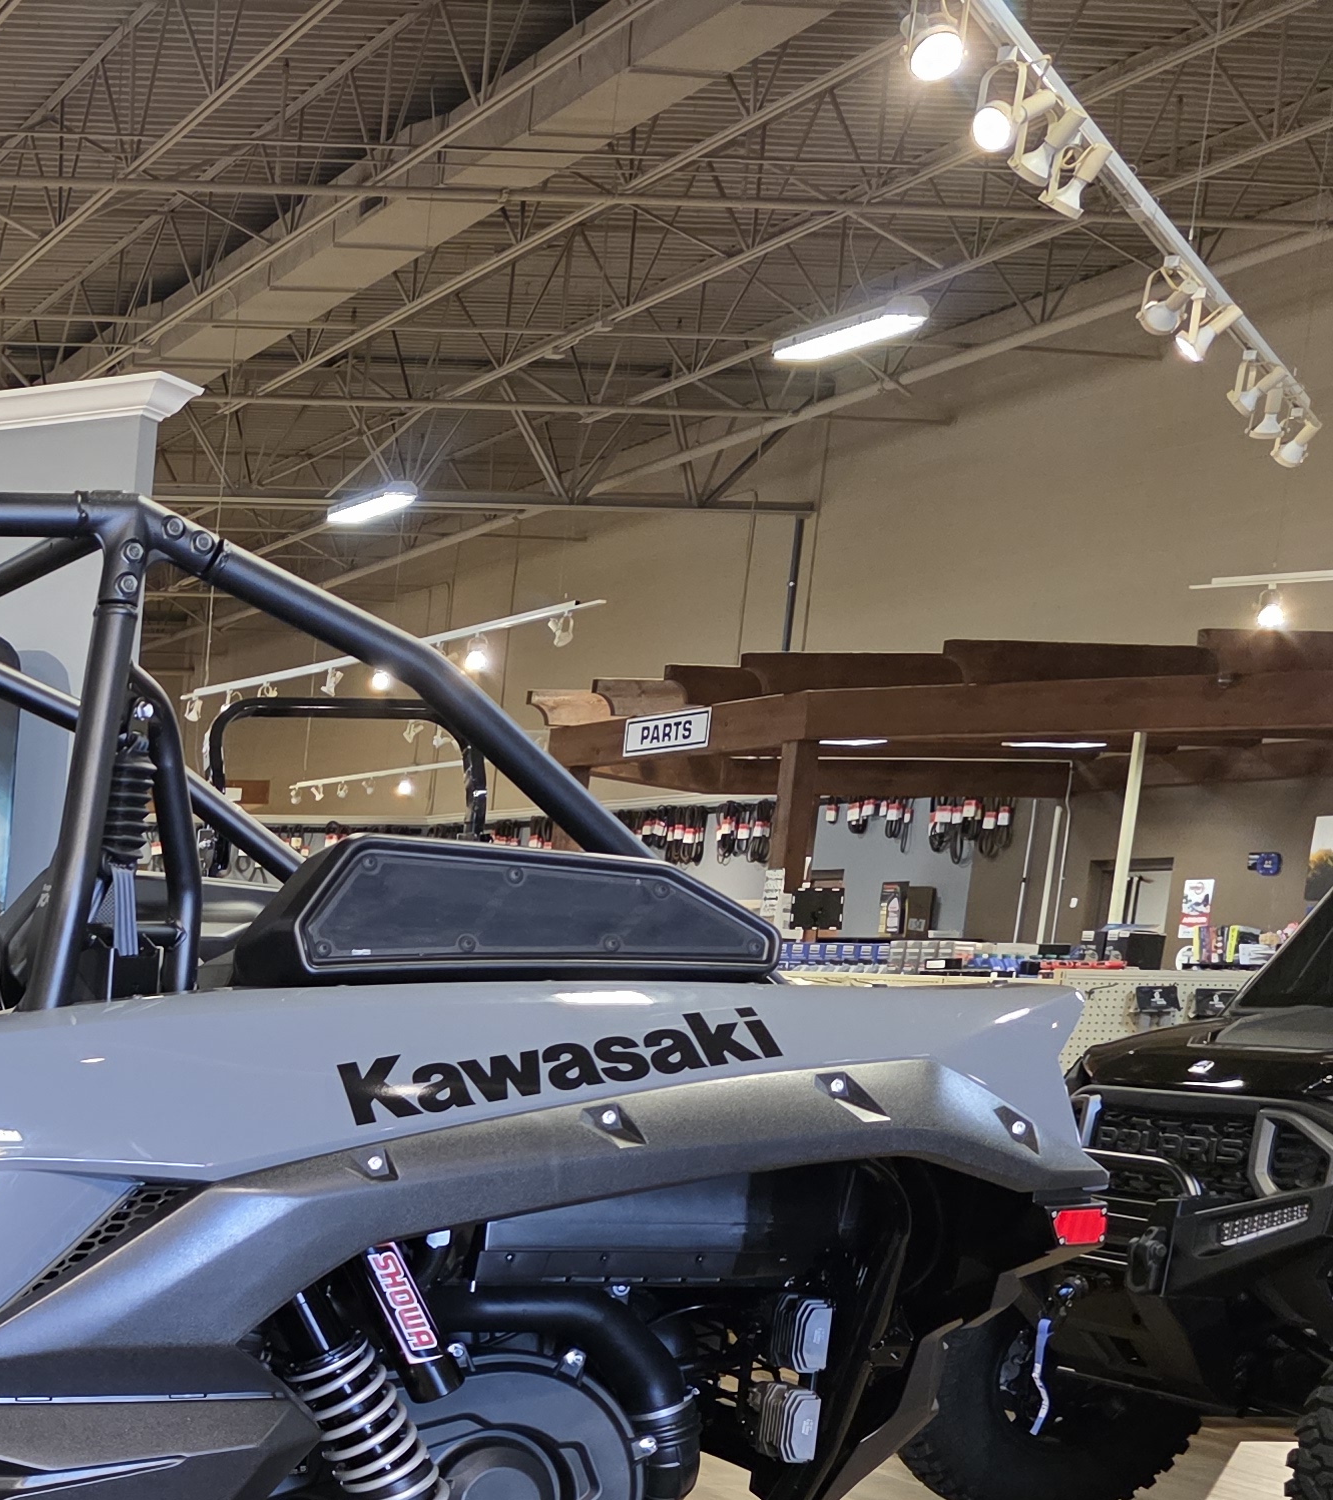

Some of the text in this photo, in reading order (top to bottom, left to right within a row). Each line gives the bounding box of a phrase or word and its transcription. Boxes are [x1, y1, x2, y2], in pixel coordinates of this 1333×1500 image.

[640, 720, 692, 745] PARTS
[336, 1007, 783, 1126] Kawasaki
[1098, 1125, 1246, 1164] POLARIS
[367, 1251, 438, 1352] SHOWA
